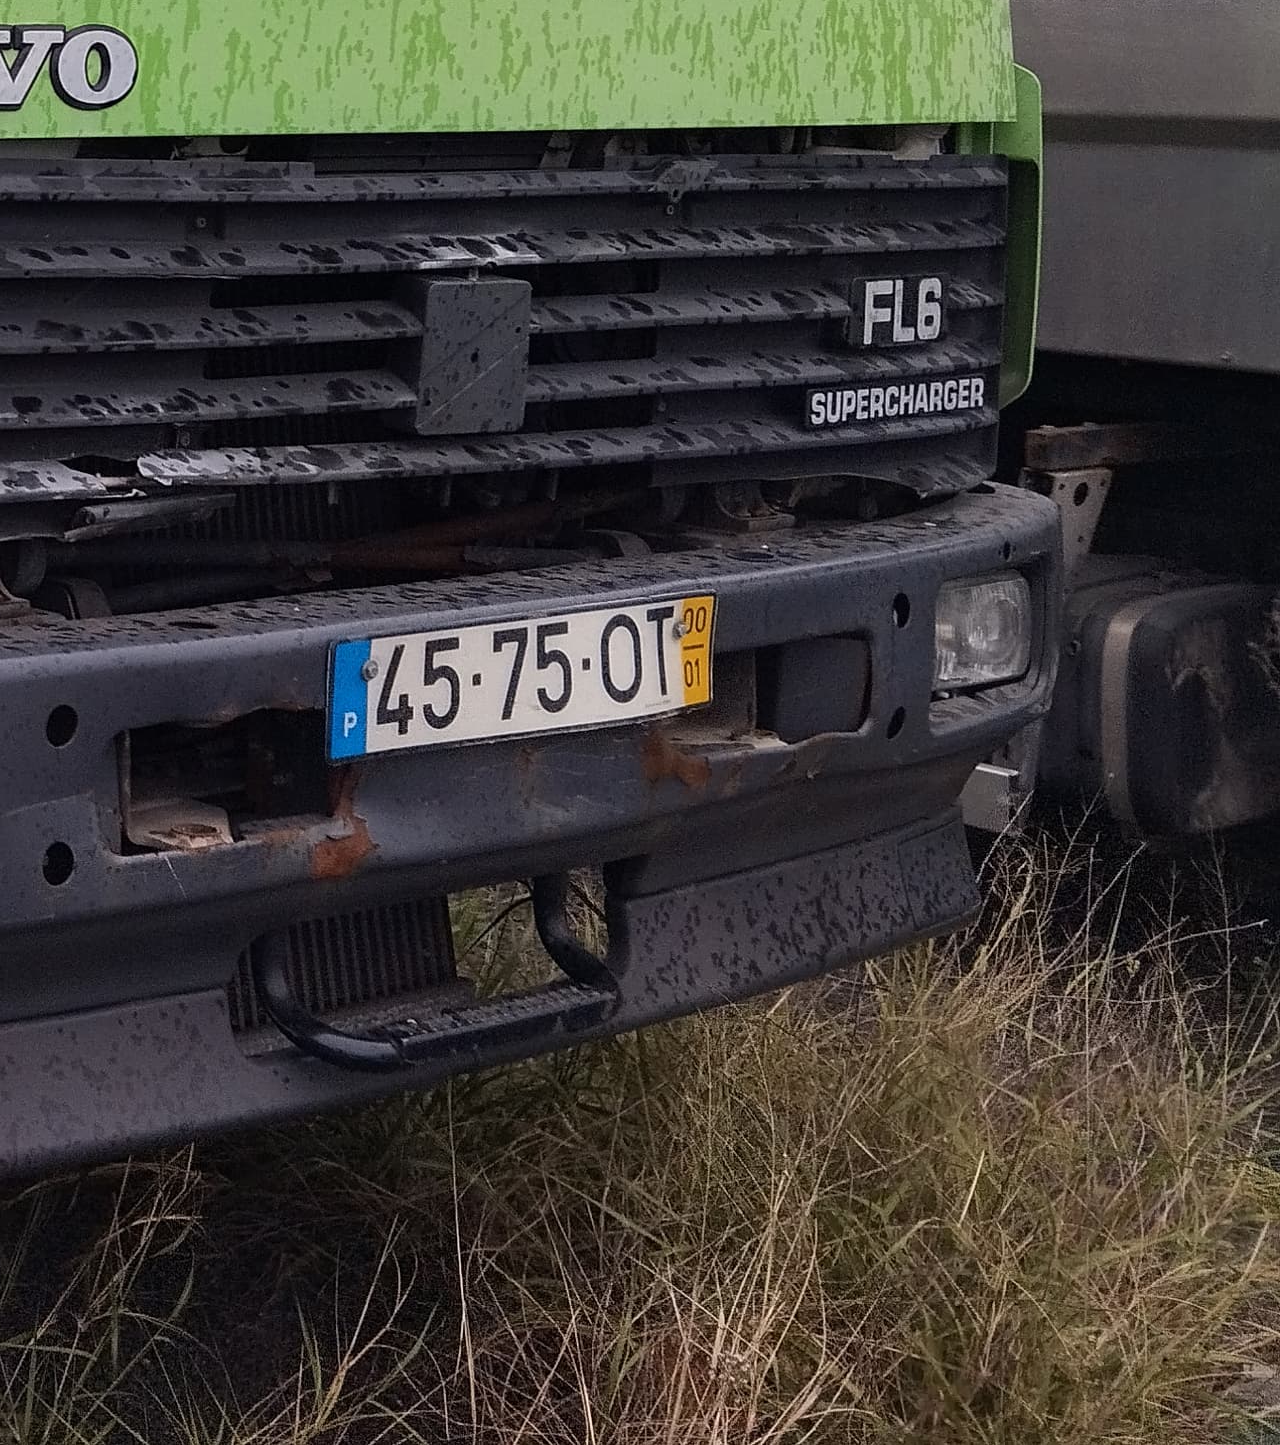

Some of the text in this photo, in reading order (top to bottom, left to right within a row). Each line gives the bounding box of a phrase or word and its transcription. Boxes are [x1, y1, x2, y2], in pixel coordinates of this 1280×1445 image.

[863, 277, 942, 345] FL6
[810, 377, 985, 425] SUPERCHARGER
[683, 606, 707, 634] 00
[684, 658, 700, 688] 01
[343, 711, 358, 739] P
